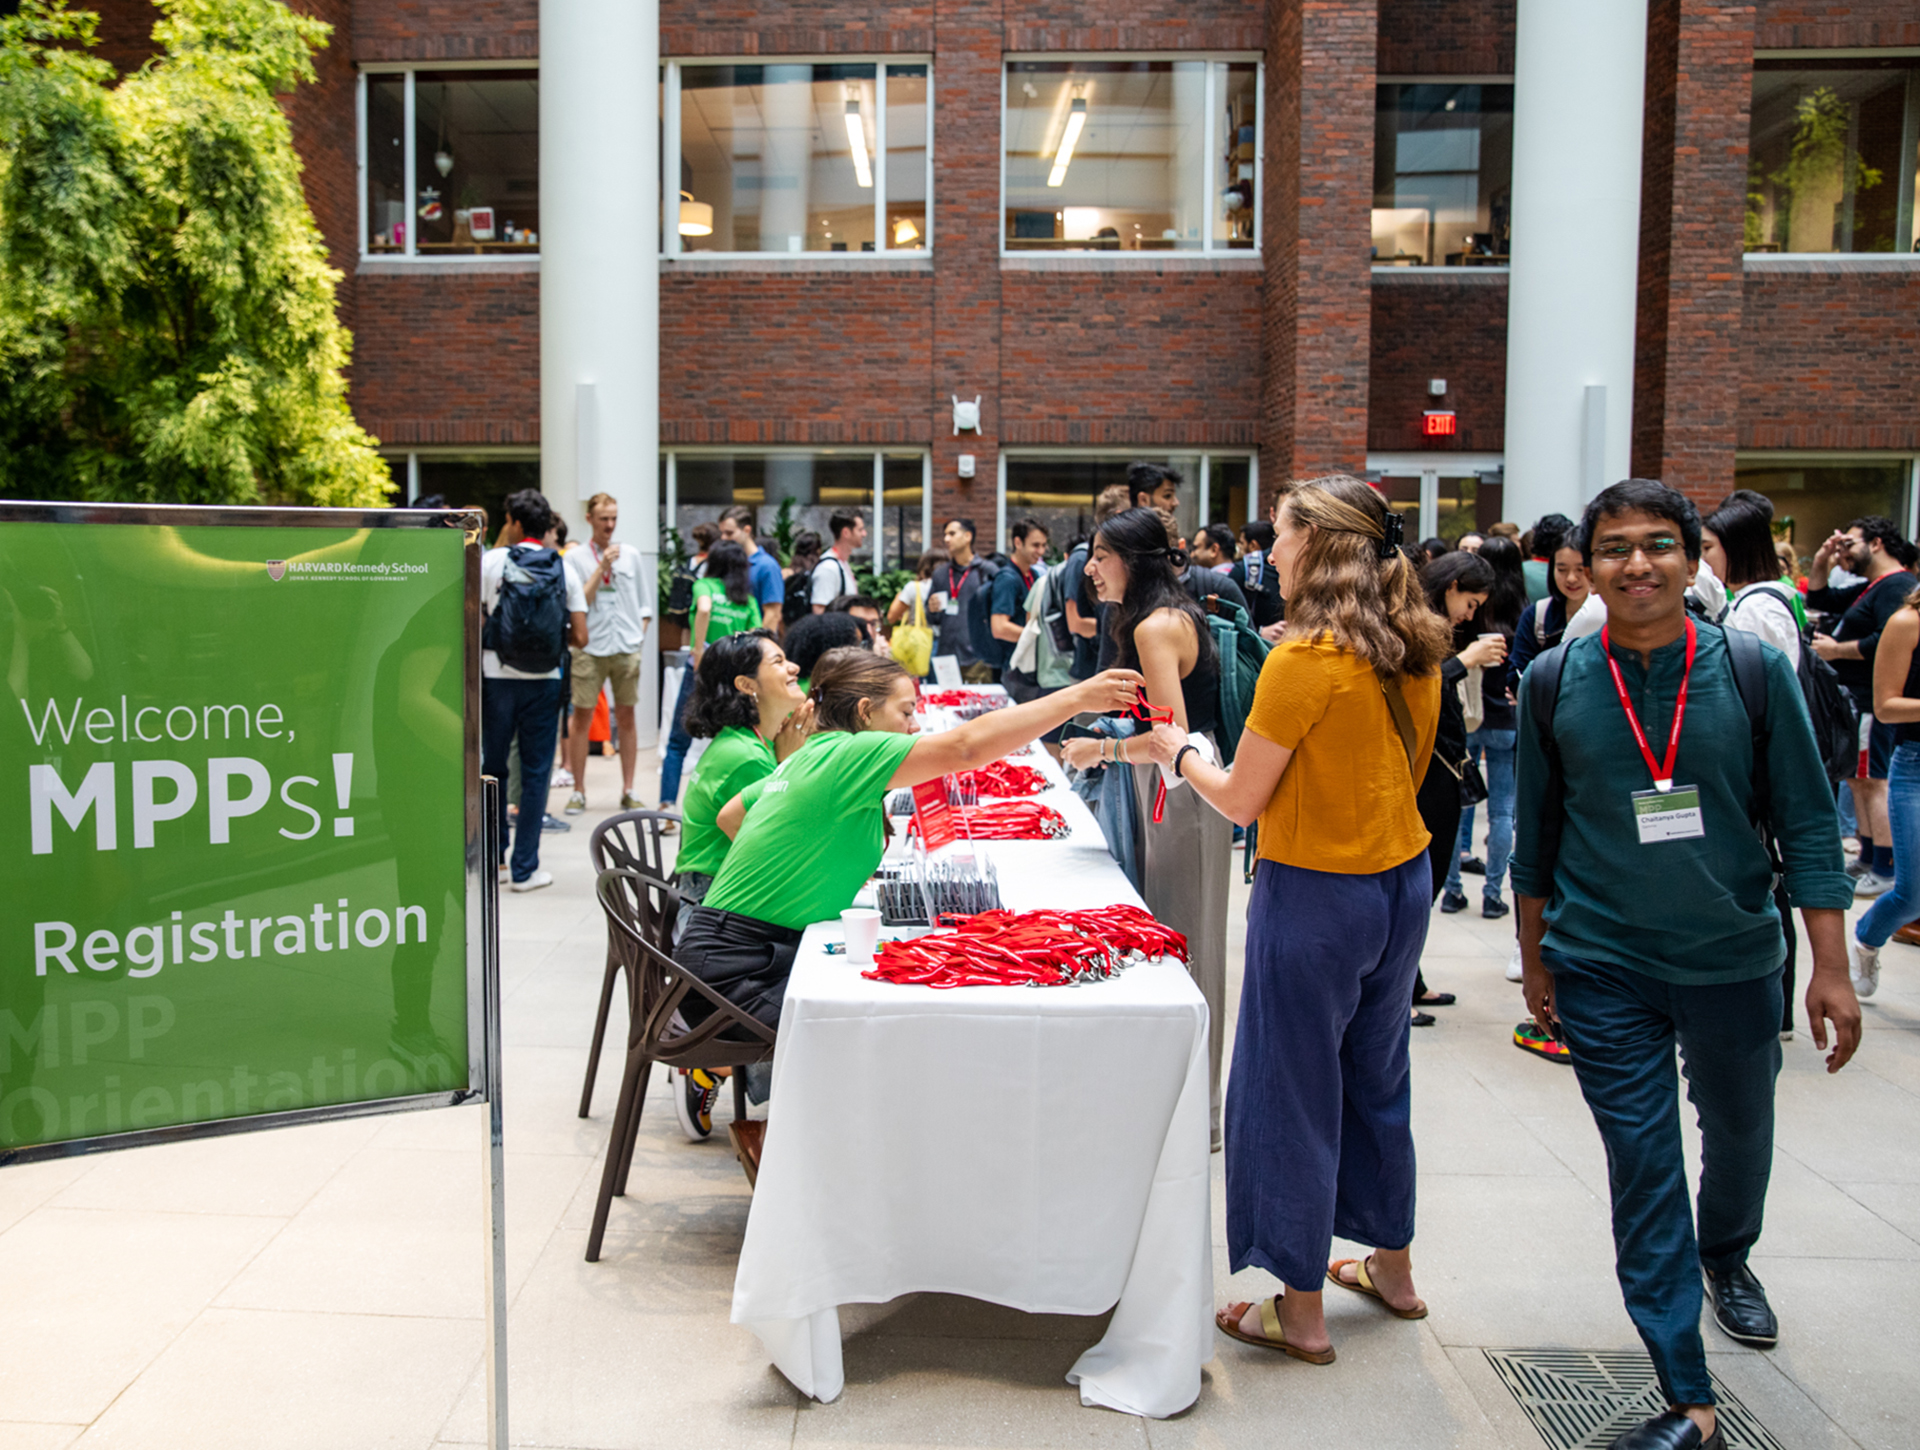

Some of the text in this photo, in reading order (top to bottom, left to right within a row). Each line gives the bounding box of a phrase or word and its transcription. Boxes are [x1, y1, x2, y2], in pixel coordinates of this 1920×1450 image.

[1427, 415, 1452, 434] EXIT
[288, 562, 429, 576] HARVARD Kennedy School
[20, 694, 295, 746] Welcome,
[29, 752, 355, 855] MPPs!
[1641, 811, 1697, 824] Chaitanya Gupta
[34, 898, 428, 978] Registration
[0, 994, 176, 1074] MPP
